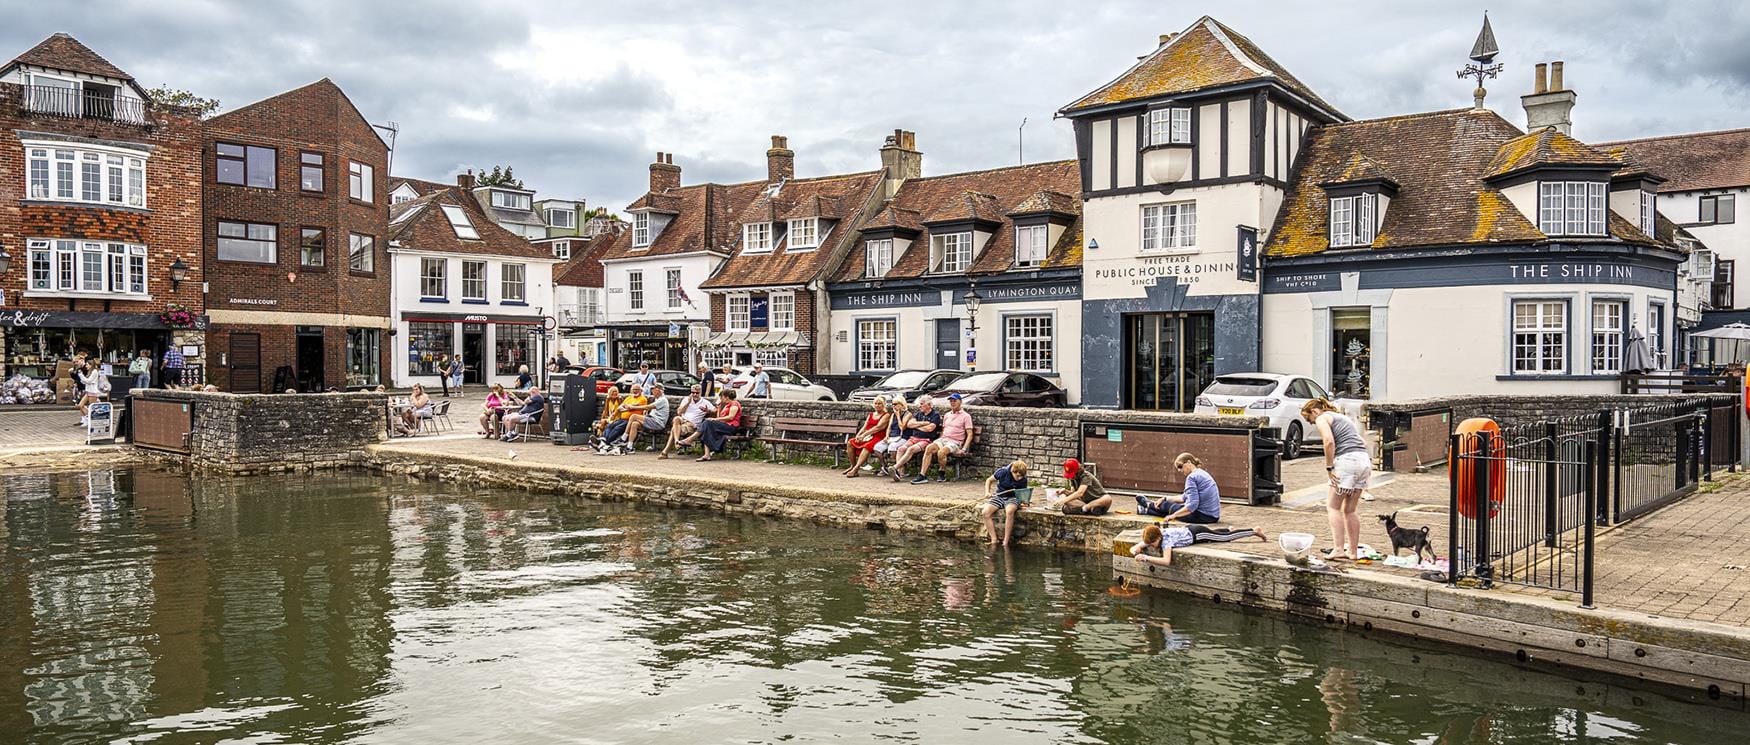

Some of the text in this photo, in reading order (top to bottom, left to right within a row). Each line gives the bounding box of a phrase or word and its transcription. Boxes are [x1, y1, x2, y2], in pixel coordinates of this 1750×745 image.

[1095, 262, 1238, 279] PUBLIC HOUSE & DININ
[1510, 264, 1633, 279] THE SHIP INN
[1131, 276, 1200, 286] SINCE 1850
[988, 285, 1078, 298] LYMINGTON QUAY
[847, 293, 922, 305] THE SHIP INN
